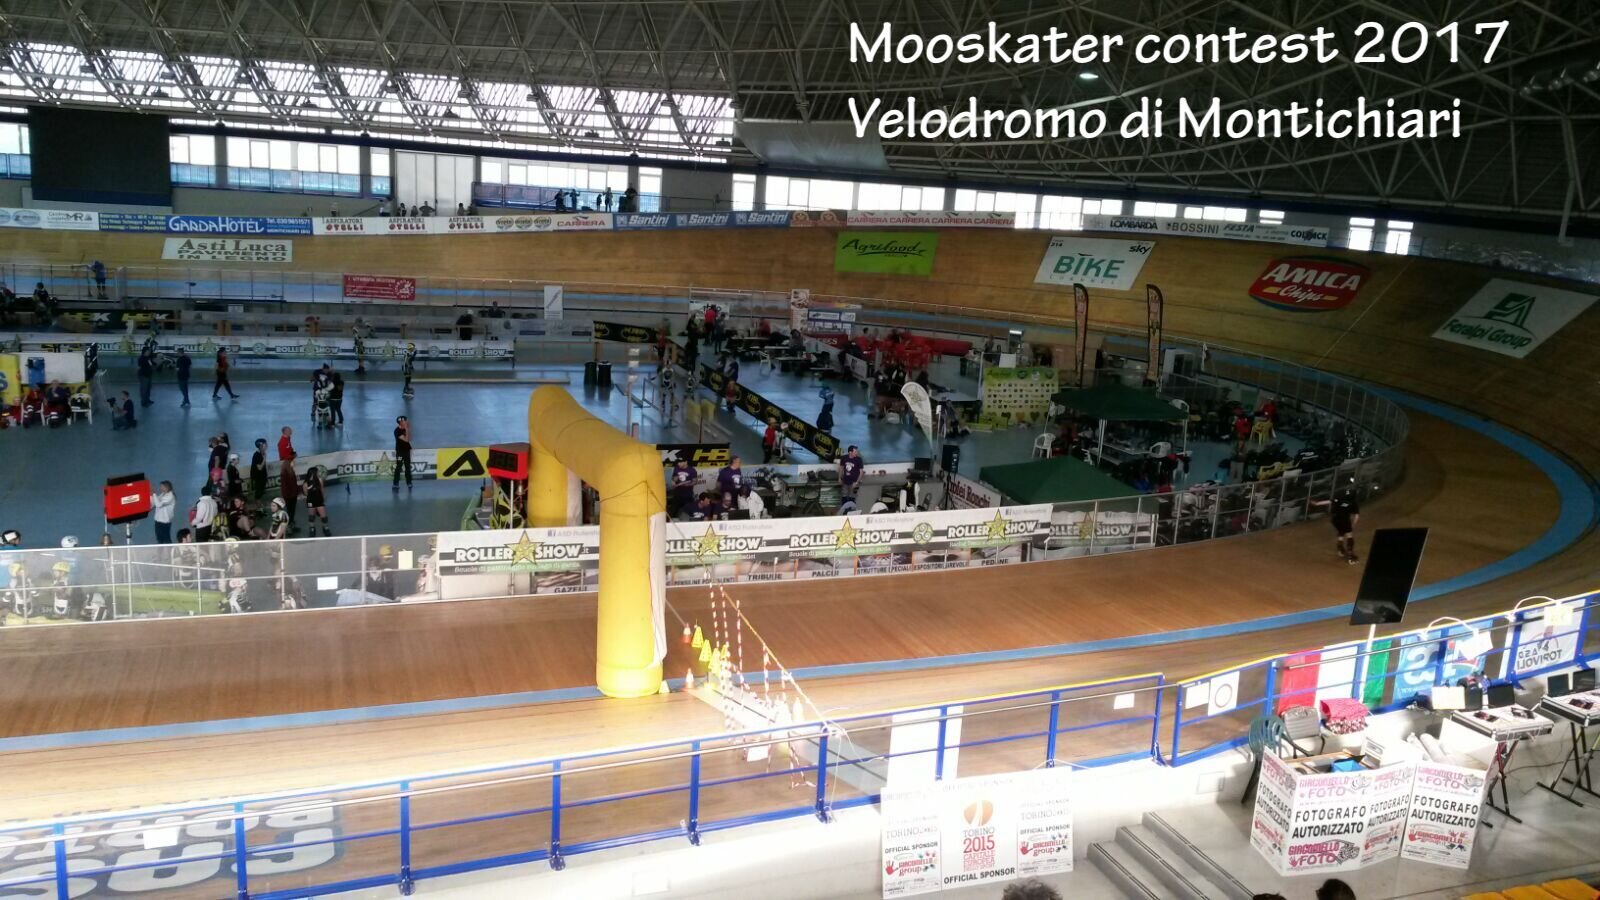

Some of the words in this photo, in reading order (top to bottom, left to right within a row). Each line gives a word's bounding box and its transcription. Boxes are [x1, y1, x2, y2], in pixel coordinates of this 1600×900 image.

[557, 219, 606, 227] CARRERA
[628, 214, 670, 225] Santini
[688, 213, 729, 224] Santini
[748, 212, 788, 224] Santini
[848, 216, 889, 224] CARRERA
[889, 216, 930, 224] CARRERA
[932, 217, 974, 225] CARRERA
[973, 217, 1015, 225] CARRERA
[1110, 220, 1158, 230] LOMBARDA
[1172, 222, 1220, 234] BOSSINI
[1223, 223, 1255, 233] FESTA
[178, 239, 226, 251] Asti
[234, 240, 288, 252] Luca
[842, 238, 921, 254] Agrifood
[1128, 244, 1152, 255] sky
[1053, 255, 1126, 279] BIKE
[1262, 263, 1361, 291] AMICA
[1279, 285, 1324, 303] Chips
[1443, 319, 1489, 340] Feralpi
[1487, 329, 1532, 349] Group
[337, 463, 378, 474] ROLLER
[947, 524, 989, 539] ROLLER
[1005, 520, 1037, 533] SHOW
[1096, 523, 1133, 536] SHOW
[719, 537, 762, 551] SHOW
[789, 533, 836, 549] ROLLER
[854, 529, 894, 544] SHOW
[455, 546, 513, 563] ROLLER
[535, 543, 581, 558] SHOW
[1379, 778, 1400, 790] FOTO
[1425, 775, 1461, 790] FOTO
[1307, 785, 1346, 799] FOTO
[1259, 780, 1292, 819] FOTOGRAFO
[1370, 794, 1410, 814] FOTOGRAFO
[1414, 794, 1479, 815] FOTOGRAFO
[1257, 796, 1290, 833] AUTORIZZATO
[1295, 805, 1367, 823] FOTOGRAFO
[1367, 807, 1408, 828] AUTORIZZATO
[1411, 808, 1477, 829] AUTORIZZATO
[962, 826, 995, 838] TORINO
[1020, 827, 1044, 836] OFFICIAL
[1045, 823, 1070, 832] SPONSOR
[1292, 821, 1365, 840] AUTORIZZATO
[885, 844, 910, 854] OFFICIAL
[911, 841, 939, 851] SPONSOR
[963, 834, 995, 854] 2015
[1033, 846, 1055, 857] group
[1298, 852, 1337, 866] FOTO
[899, 866, 923, 877] group
[943, 870, 979, 884] OFFICIAL
[980, 867, 1015, 879] SPONSOR
